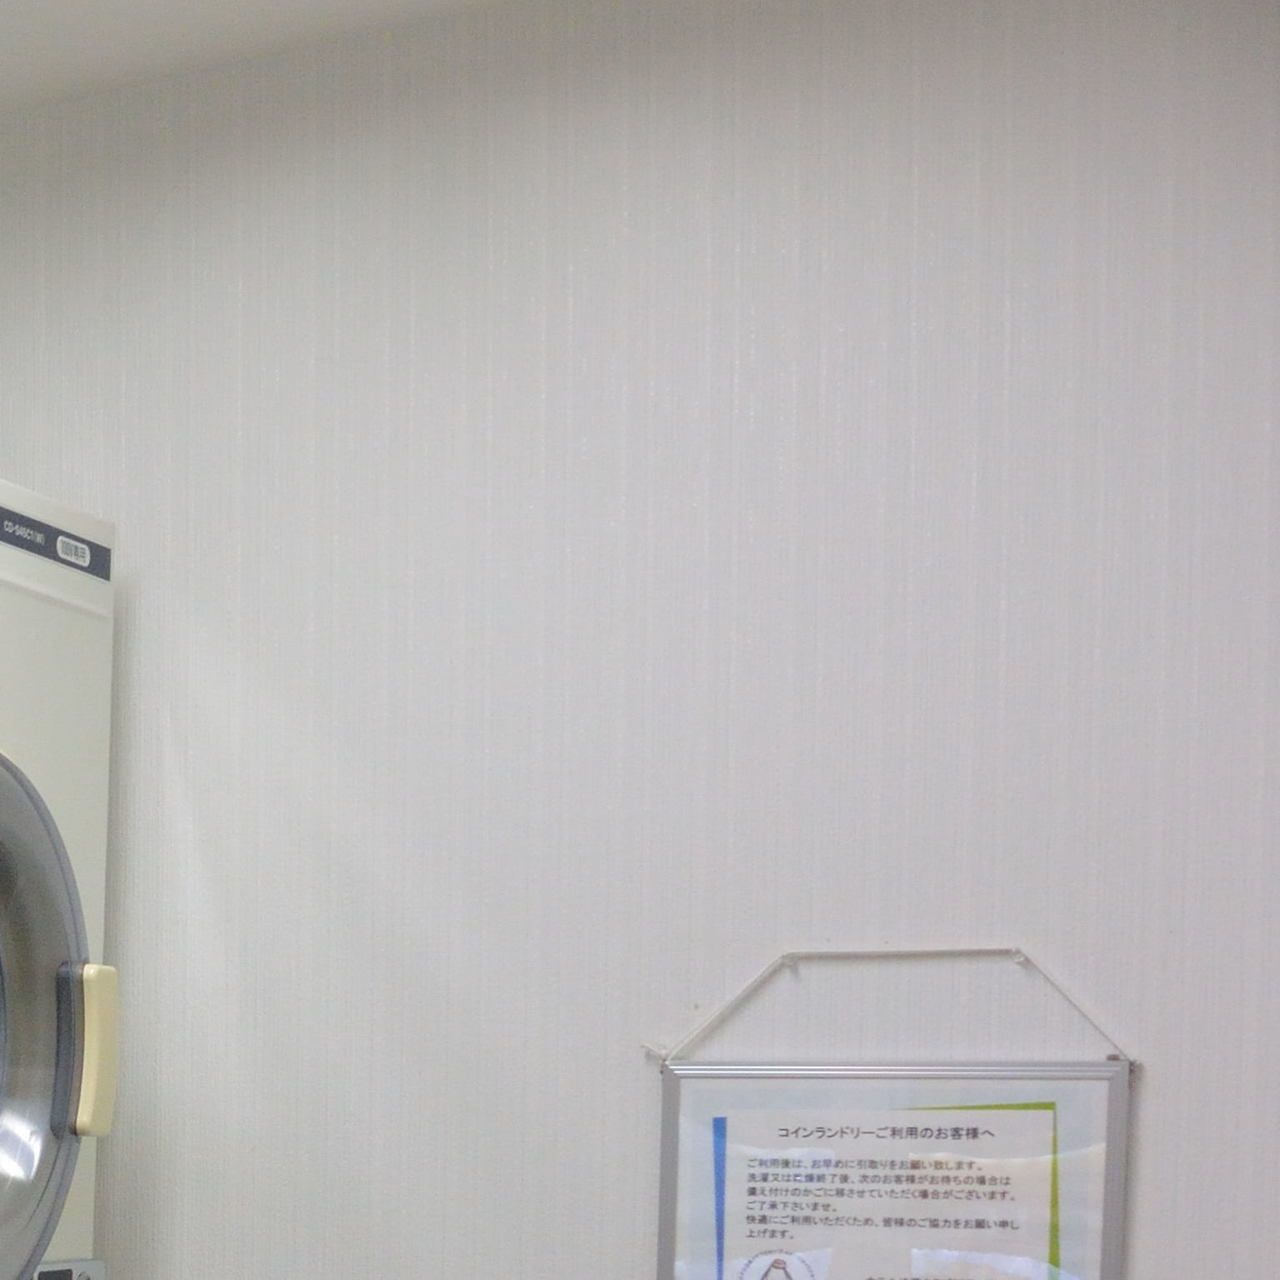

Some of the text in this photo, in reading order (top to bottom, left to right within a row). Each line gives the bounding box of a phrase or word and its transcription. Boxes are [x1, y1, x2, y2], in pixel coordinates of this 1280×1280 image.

[778, 1125, 996, 1140] コインランドリーご利用のお客様へ
[746, 1201, 838, 1212] ご了承下さいませ。
[746, 1228, 795, 1240] 上げます。
